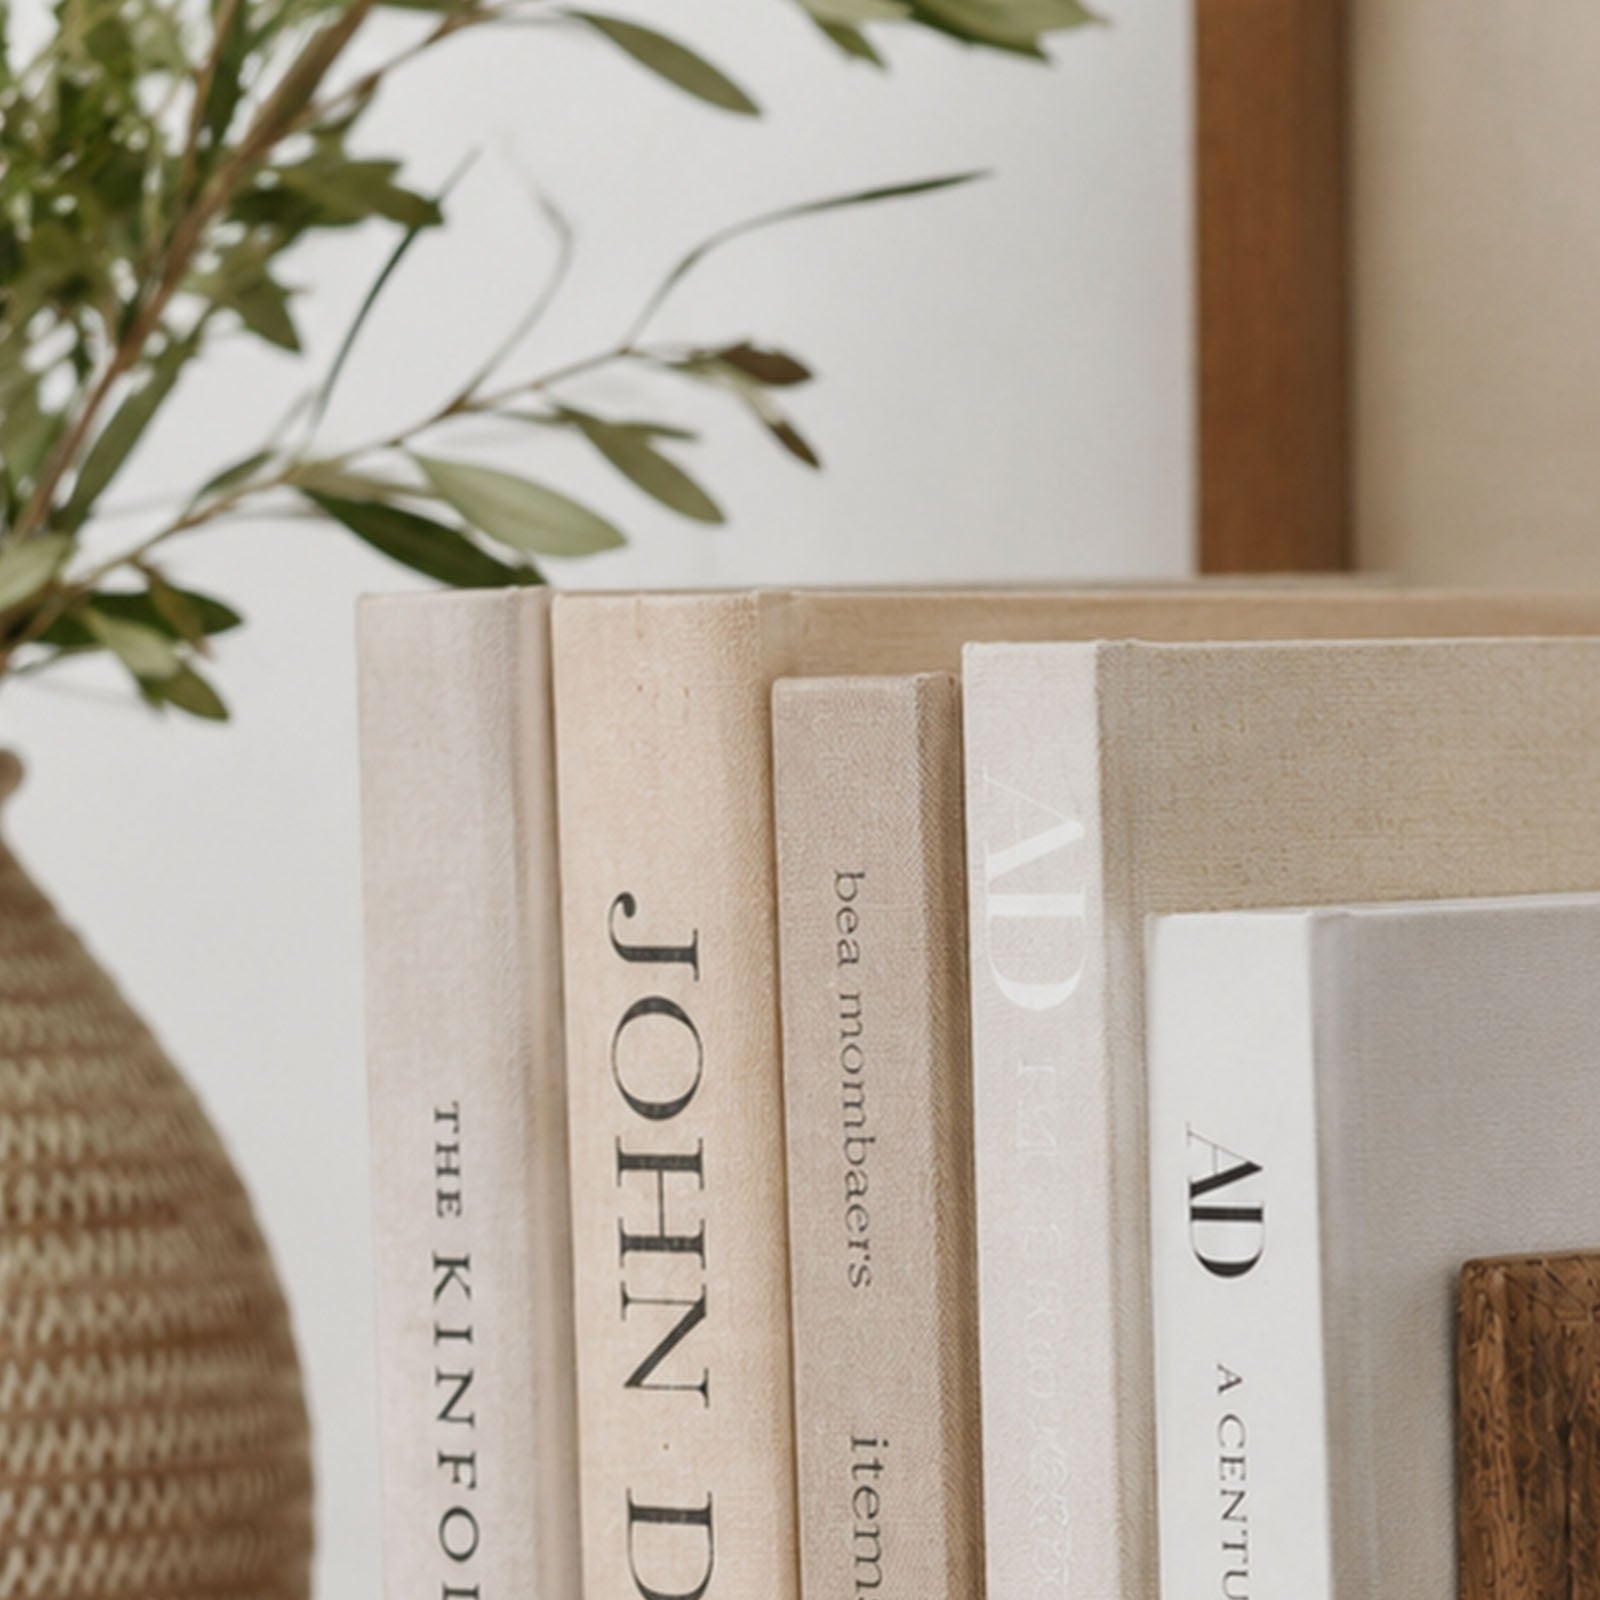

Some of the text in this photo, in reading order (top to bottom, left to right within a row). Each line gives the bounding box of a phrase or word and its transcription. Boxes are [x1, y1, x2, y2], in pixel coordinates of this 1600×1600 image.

[982, 765, 1087, 1010] AD
[432, 1100, 464, 1220] THE
[607, 890, 711, 1410] JOHN
[834, 869, 877, 1290] bea mombaers
[1185, 1122, 1270, 1281] AD
[1216, 1363, 1244, 1396] A
